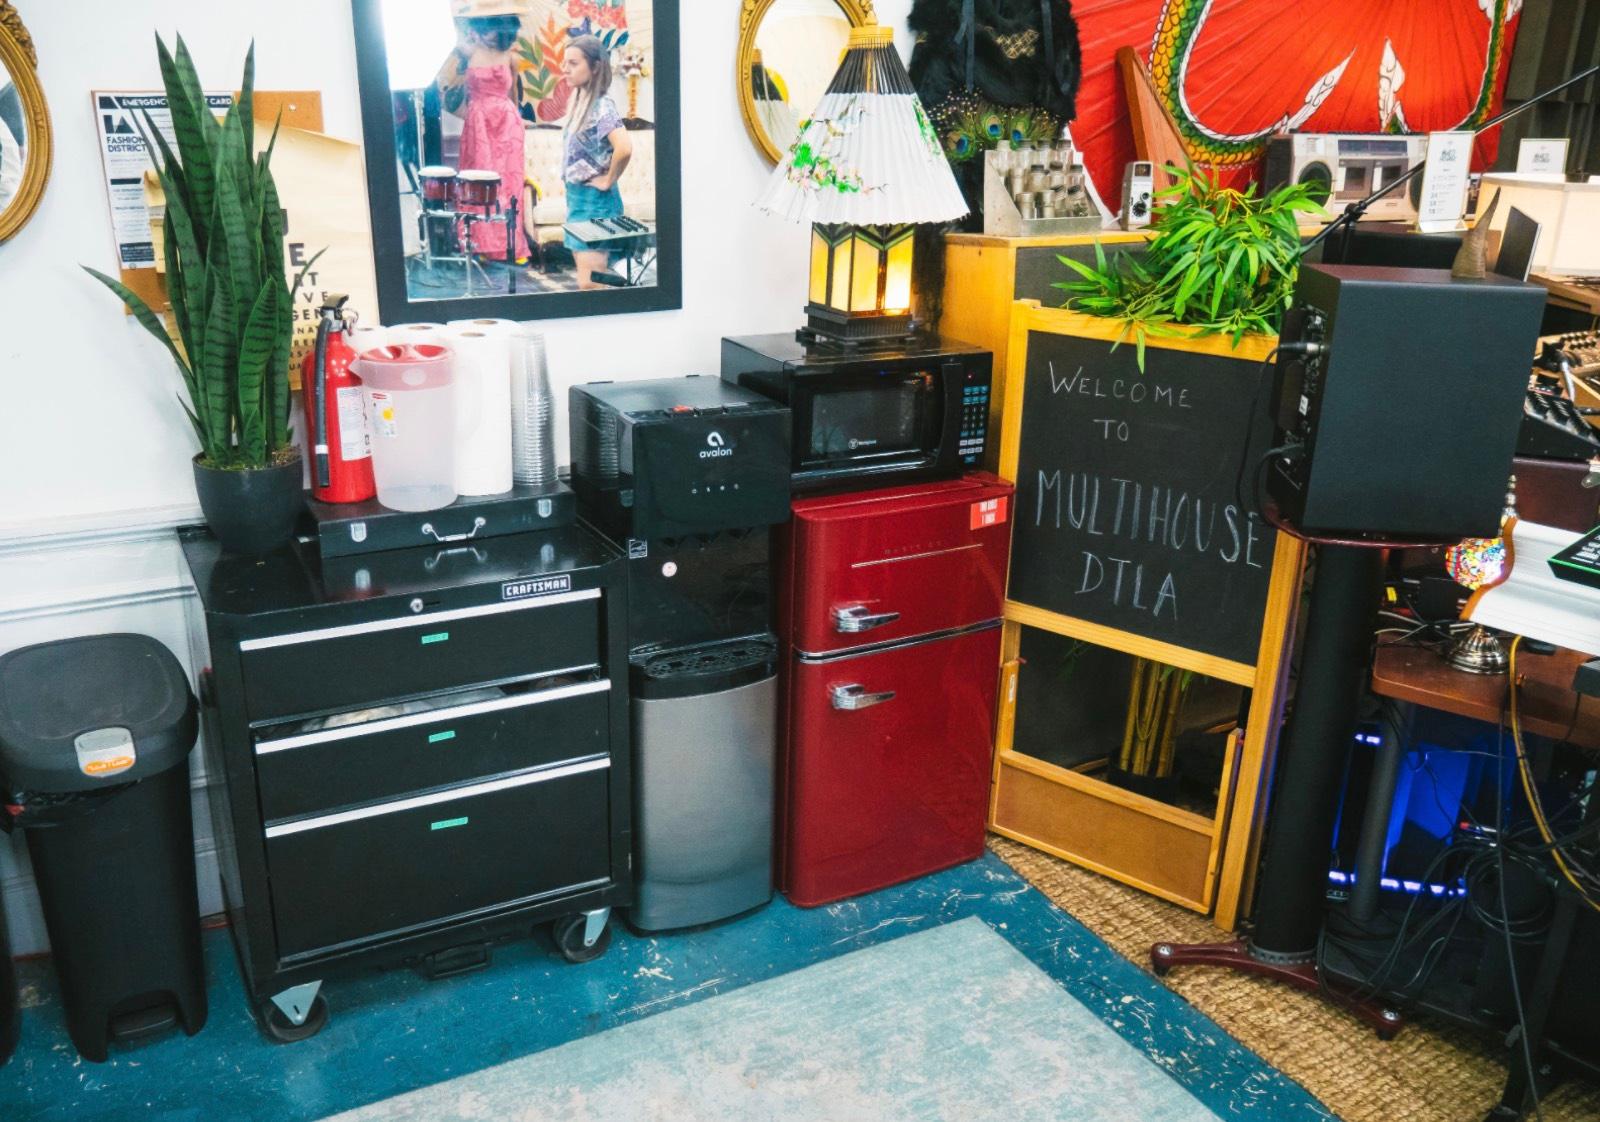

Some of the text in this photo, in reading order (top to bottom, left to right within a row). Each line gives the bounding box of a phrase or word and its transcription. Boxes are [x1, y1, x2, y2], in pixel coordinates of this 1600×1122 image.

[122, 98, 167, 106] EMERGENC
[107, 136, 146, 145] FASHION
[108, 144, 147, 152] DISTRICT
[1049, 361, 1192, 408] WELCOME
[1093, 418, 1129, 441] TO
[700, 447, 732, 458] avalon
[1036, 469, 1262, 569] MULTIHOUSE
[506, 578, 567, 597] CRAFTSMAN
[1074, 551, 1178, 620] DTLA
